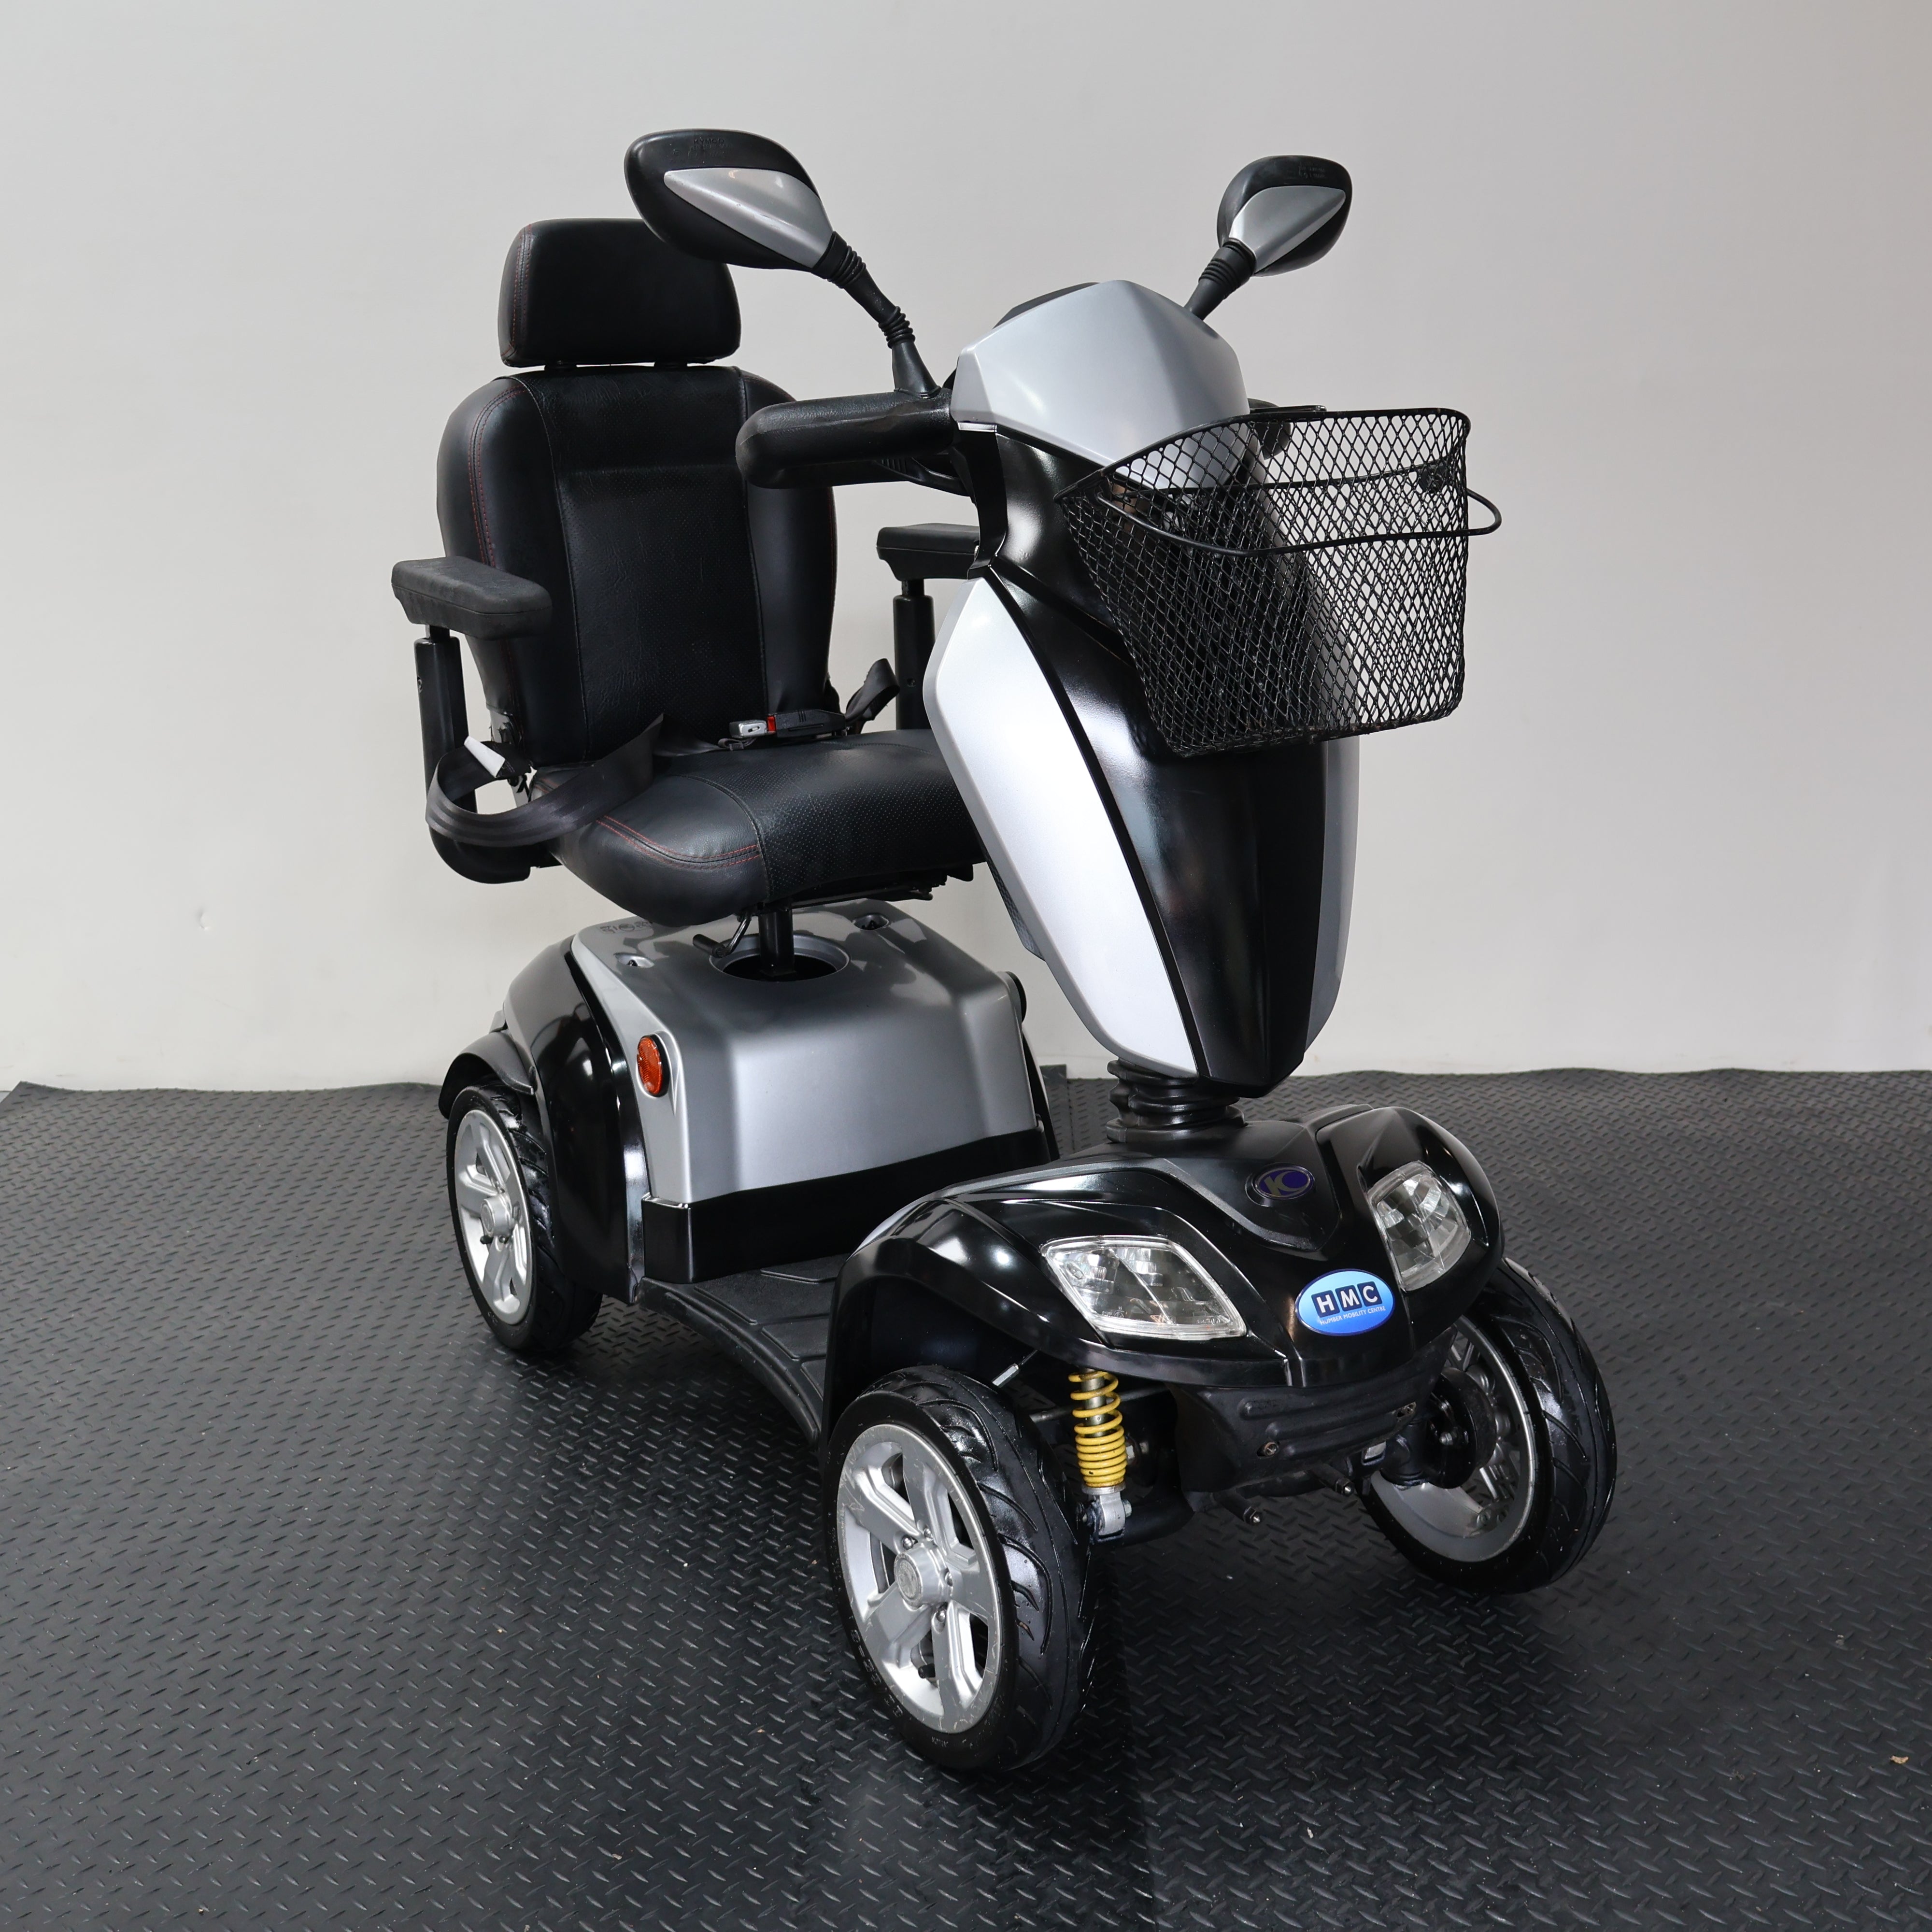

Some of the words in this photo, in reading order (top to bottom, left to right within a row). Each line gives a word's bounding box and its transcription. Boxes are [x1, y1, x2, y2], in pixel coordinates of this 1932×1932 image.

[1316, 1285, 1378, 1313] HMC
[1320, 1315, 1343, 1325] HUMBER
[1343, 1309, 1366, 1319] MOBILITY
[1367, 1306, 1386, 1314] CENTRE
